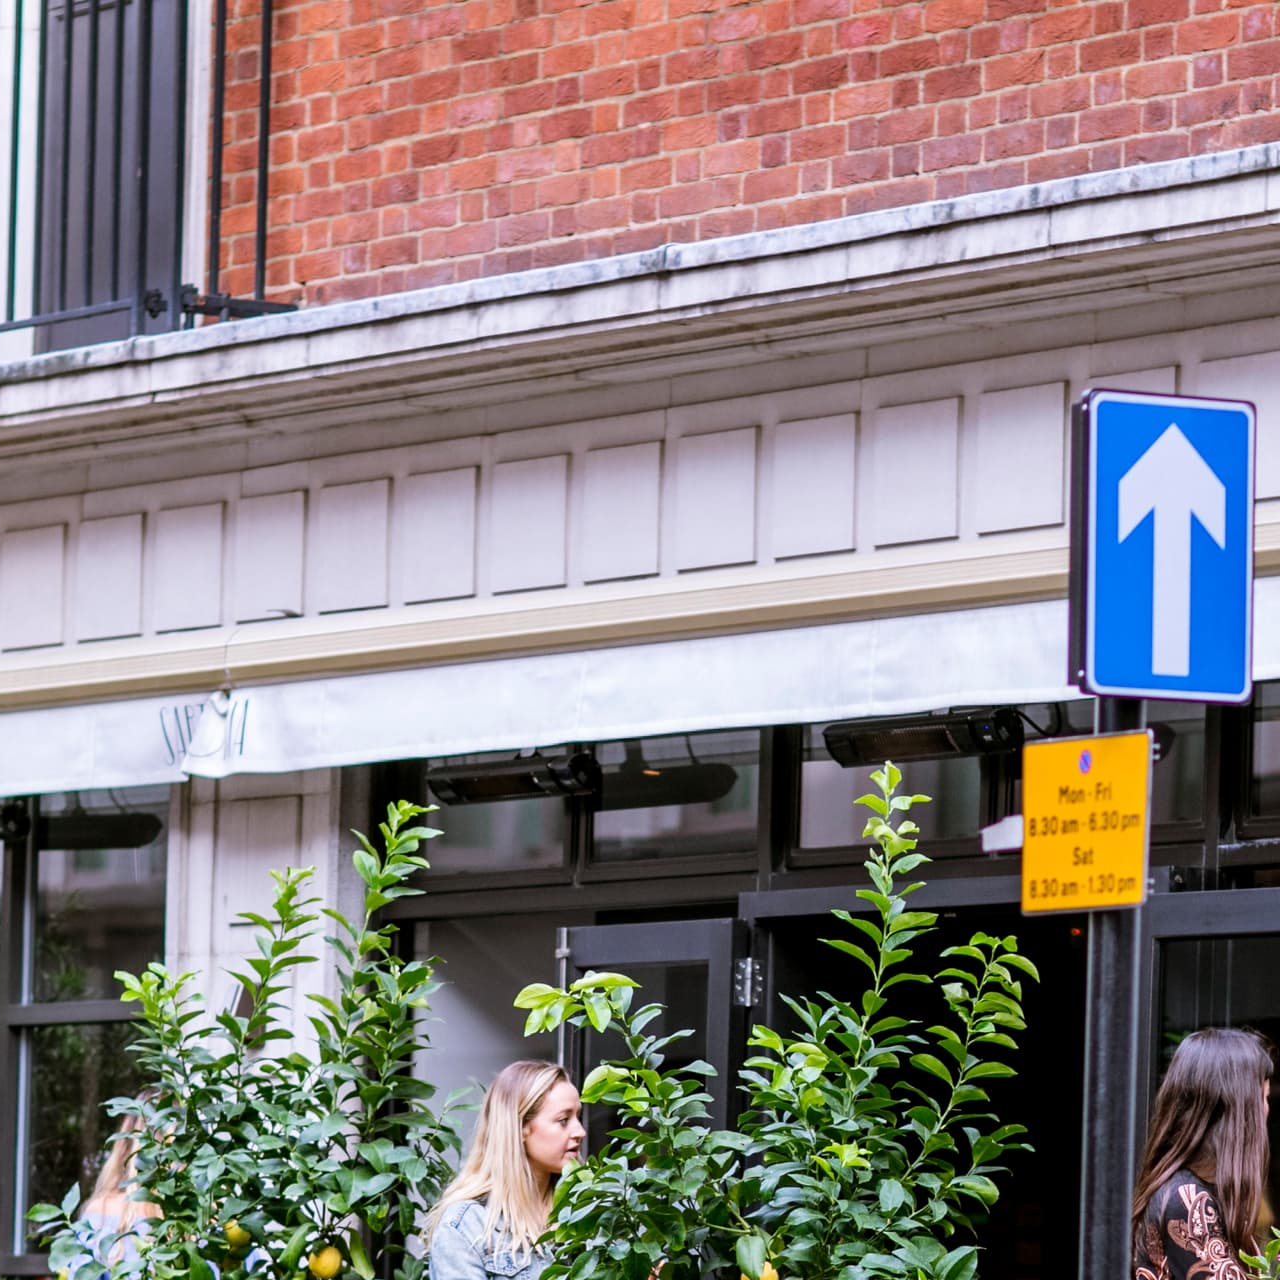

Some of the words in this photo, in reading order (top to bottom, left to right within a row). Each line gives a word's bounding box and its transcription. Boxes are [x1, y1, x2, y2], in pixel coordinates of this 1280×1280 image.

[1058, 785, 1085, 804] Mon
[1095, 781, 1113, 801] Fri
[1029, 816, 1057, 837] 8.30
[1061, 818, 1079, 834] am
[1089, 810, 1118, 831] 6.30
[1122, 813, 1139, 831] pm
[1073, 847, 1094, 866] Sat
[1029, 878, 1057, 899] 8.30
[1061, 881, 1079, 897] am
[1088, 874, 1115, 894] 1.30
[1120, 876, 1136, 893] pm
